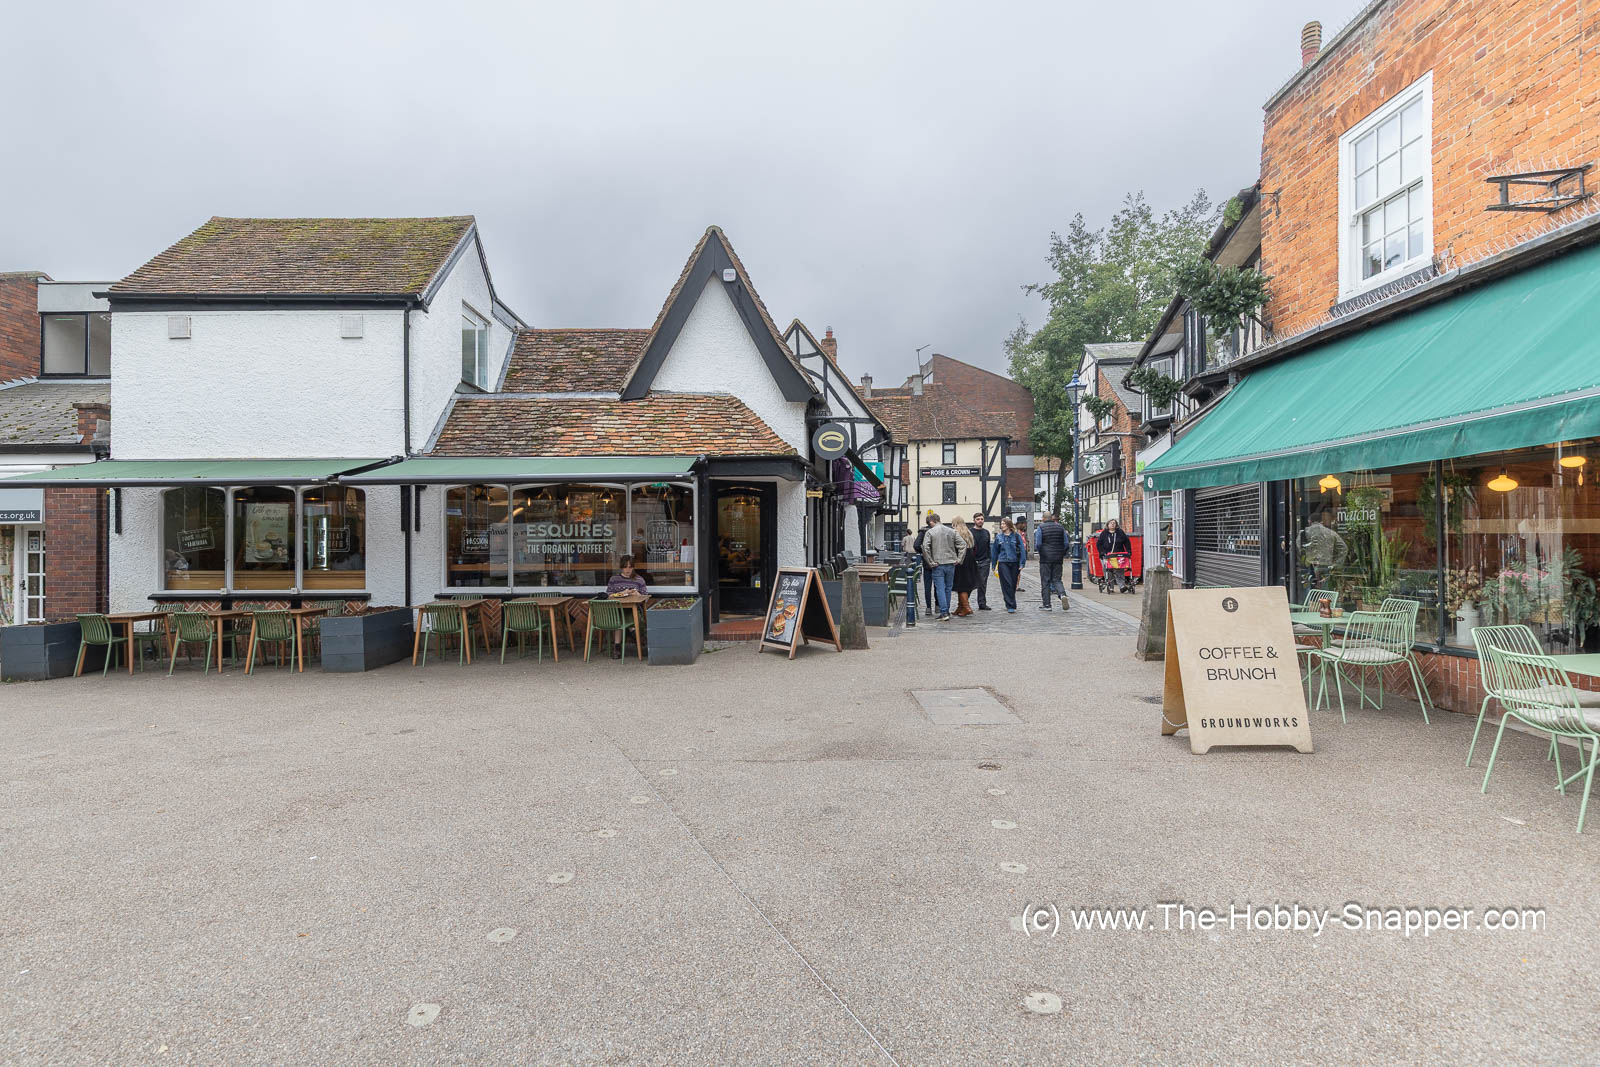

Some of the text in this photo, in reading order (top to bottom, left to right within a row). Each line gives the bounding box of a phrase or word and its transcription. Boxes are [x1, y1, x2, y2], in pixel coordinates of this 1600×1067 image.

[1337, 506, 1376, 521] matcha
[527, 524, 613, 537] ESQUIRES
[527, 544, 540, 553] THE
[542, 544, 575, 553] ORGANIC
[577, 544, 603, 553] COFFEE
[1198, 646, 1279, 660] COFFEE &
[1206, 667, 1277, 681] BRUNCH
[1201, 717, 1299, 728] GROUNDWORKS
